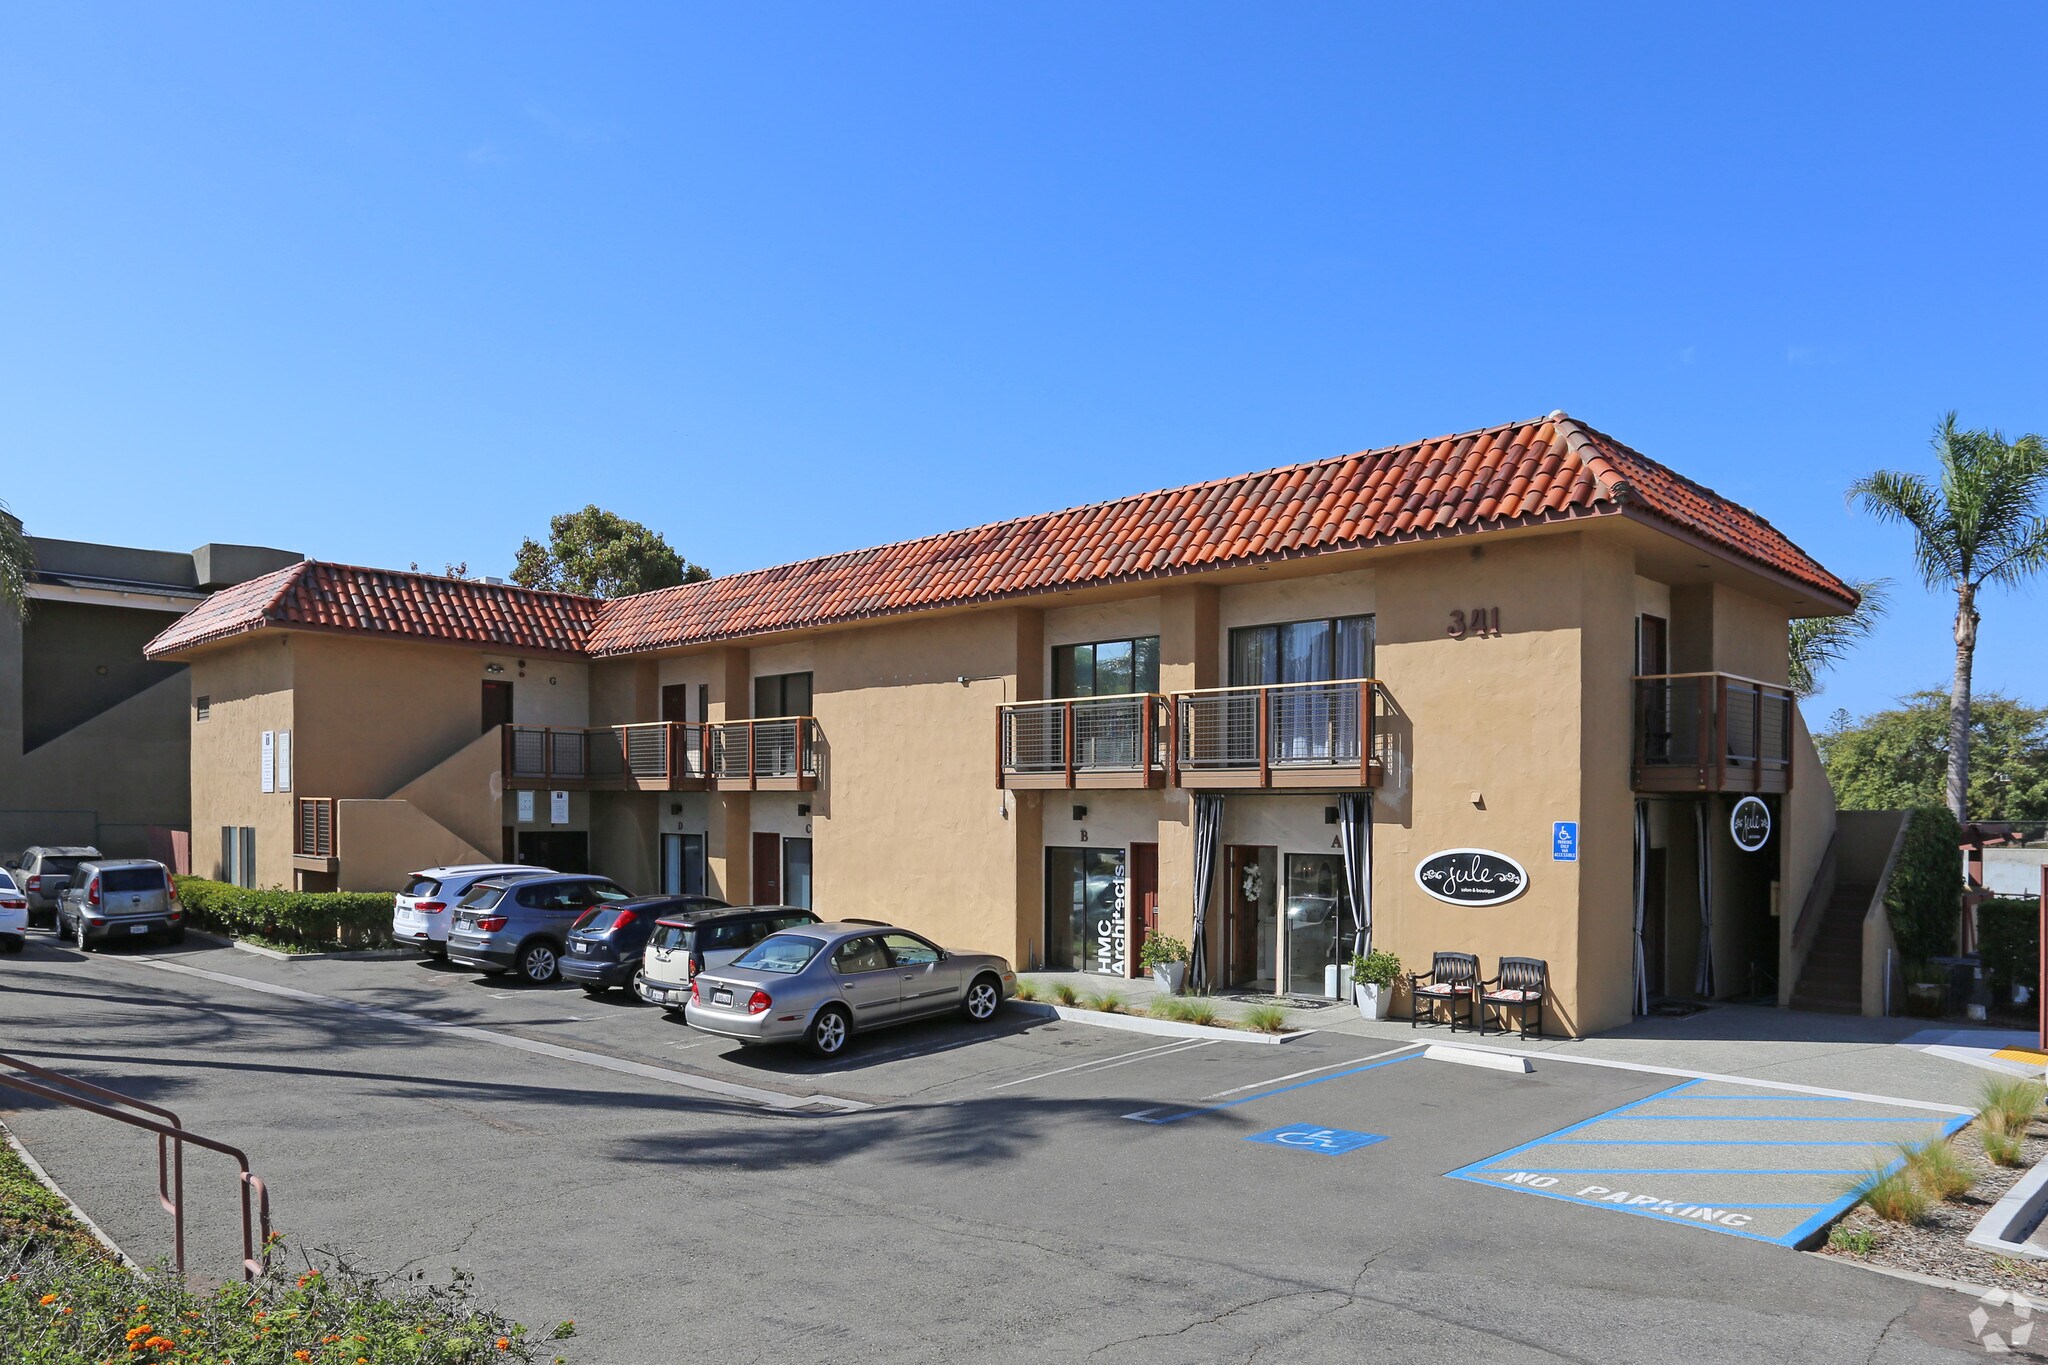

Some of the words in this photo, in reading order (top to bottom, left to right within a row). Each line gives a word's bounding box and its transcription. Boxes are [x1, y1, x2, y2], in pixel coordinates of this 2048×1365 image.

[1447, 606, 1499, 636] 341
[549, 676, 558, 686] G
[678, 822, 684, 830] D
[805, 824, 812, 833] C
[1080, 830, 1088, 842] B
[1331, 834, 1342, 848] A
[1443, 855, 1493, 895] jule
[1112, 864, 1125, 976] Architects
[1098, 919, 1111, 973] HMC
[1503, 1172, 1559, 1188] NO
[1576, 1185, 1753, 1227] PARKING
